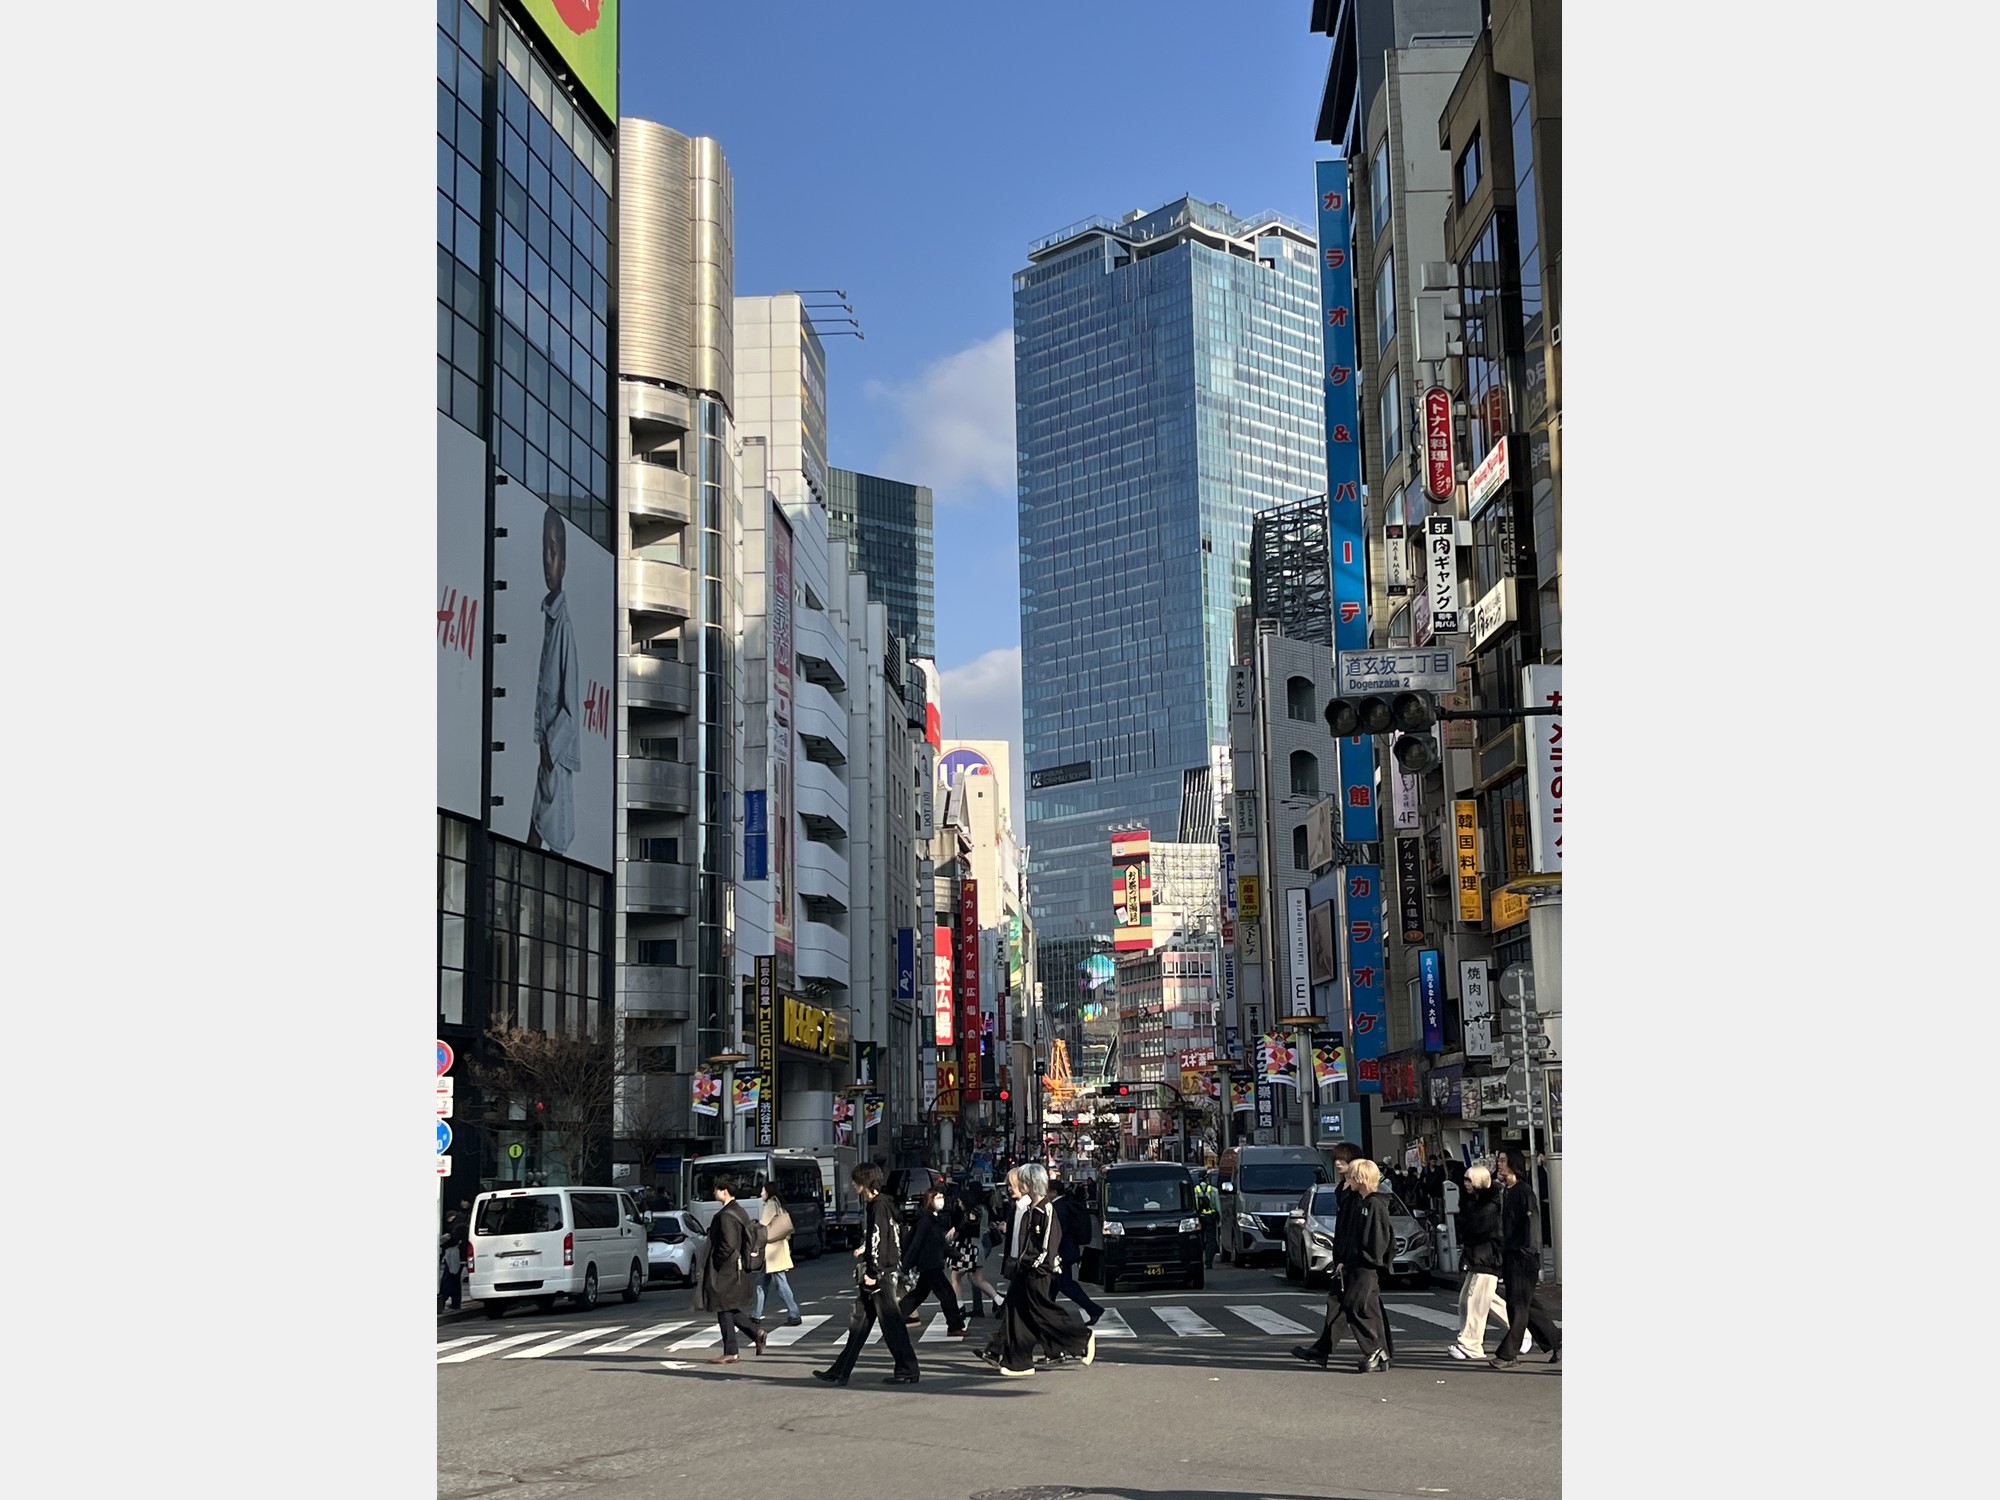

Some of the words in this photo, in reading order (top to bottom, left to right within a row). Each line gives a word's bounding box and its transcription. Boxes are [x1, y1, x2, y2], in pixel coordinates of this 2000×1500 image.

[1428, 393, 1448, 461] ベトナム料理
[1434, 523, 1448, 533] 5F
[1432, 536, 1452, 610] 肉ギャング
[437, 585, 478, 660] H&M
[1345, 654, 1449, 676] 道玄坂二丁目
[1350, 677, 1400, 690] Dogenzaka
[1403, 677, 1410, 688] 2
[583, 680, 611, 739] H&M
[1399, 810, 1416, 824] 4F
[1457, 813, 1477, 890] 韓国料理
[1296, 899, 1304, 934] lingerie
[899, 969, 913, 992] A2
[965, 899, 976, 1016] カラオケ歌広場
[1224, 952, 1235, 1000] SHIBUYA
[1350, 875, 1380, 1081] カラオケ館
[1467, 967, 1481, 996] 焼肉
[935, 956, 953, 1038] 歌広場
[760, 1102, 771, 1145] 渋谷本店
